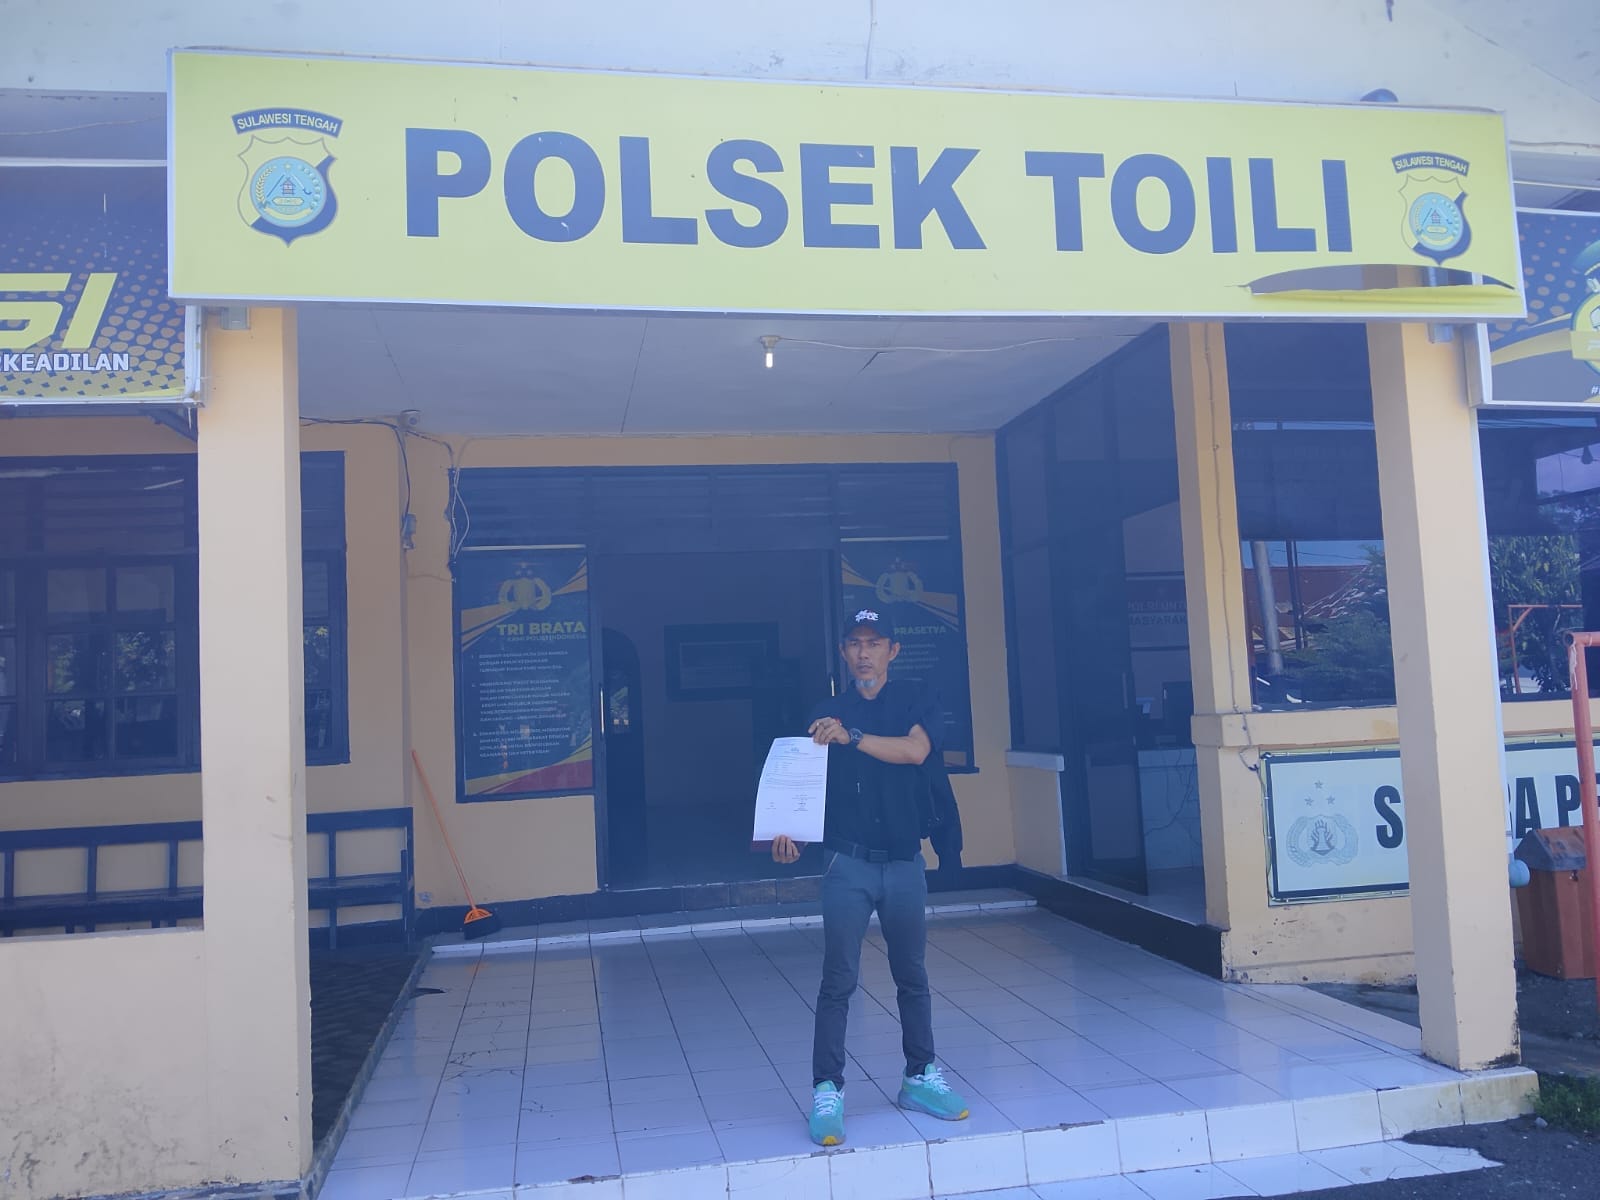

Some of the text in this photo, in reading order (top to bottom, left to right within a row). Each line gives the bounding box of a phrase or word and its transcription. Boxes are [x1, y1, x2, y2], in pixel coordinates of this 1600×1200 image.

[237, 113, 338, 134] SULAWESI TENGAH
[1394, 155, 1467, 174] SULAWESI TENGAH
[405, 127, 1353, 254] POLSEK TOILI
[0, 352, 129, 371] KEADILAN
[496, 621, 587, 636] TRI BRATA
